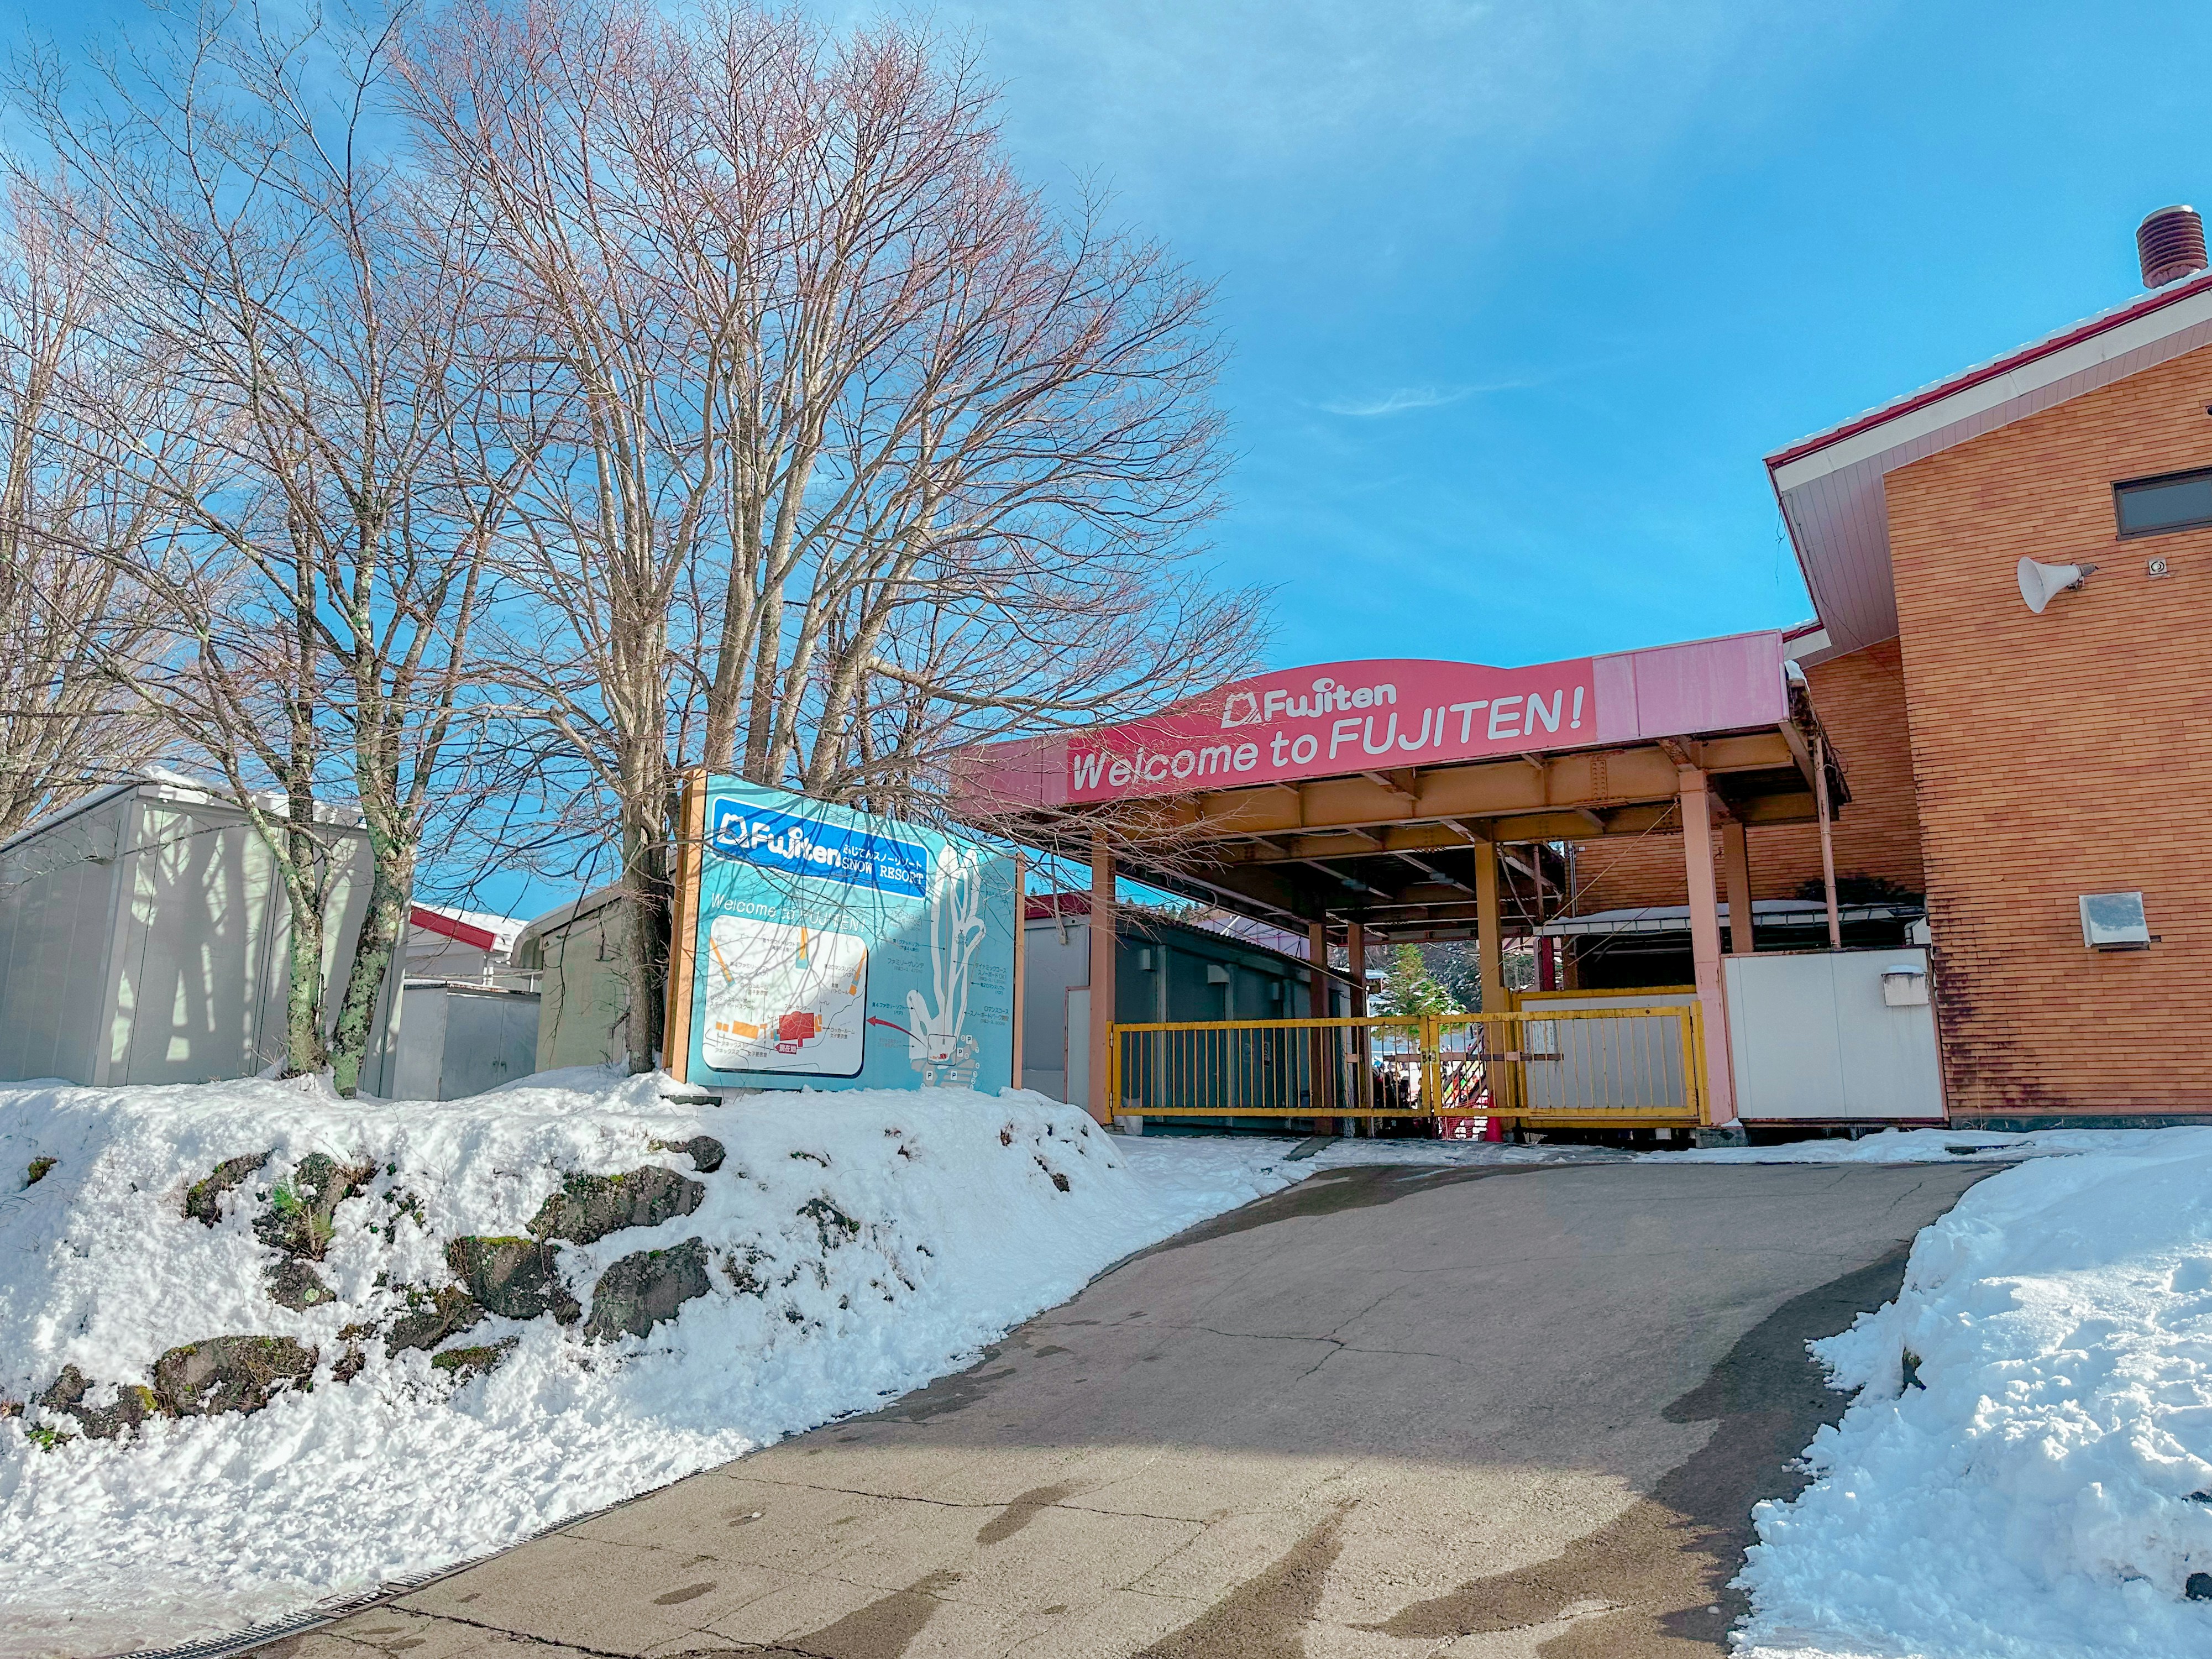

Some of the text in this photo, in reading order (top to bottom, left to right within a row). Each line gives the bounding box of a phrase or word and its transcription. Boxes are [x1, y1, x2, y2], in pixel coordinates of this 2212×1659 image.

[1264, 678, 1397, 721] Fujiten
[1073, 686, 1584, 791] Welcome to FUJITEN!
[752, 822, 841, 868] Fujiten
[843, 844, 922, 870] ふじてんスノーリゾート
[842, 857, 924, 885] SNOW RESORT
[711, 893, 776, 917] Welcome
[781, 908, 795, 920] to
[801, 909, 866, 933] FUJITEN!
[984, 1006, 1009, 1015] ロマンスコース
[779, 1044, 796, 1053] 現在地
